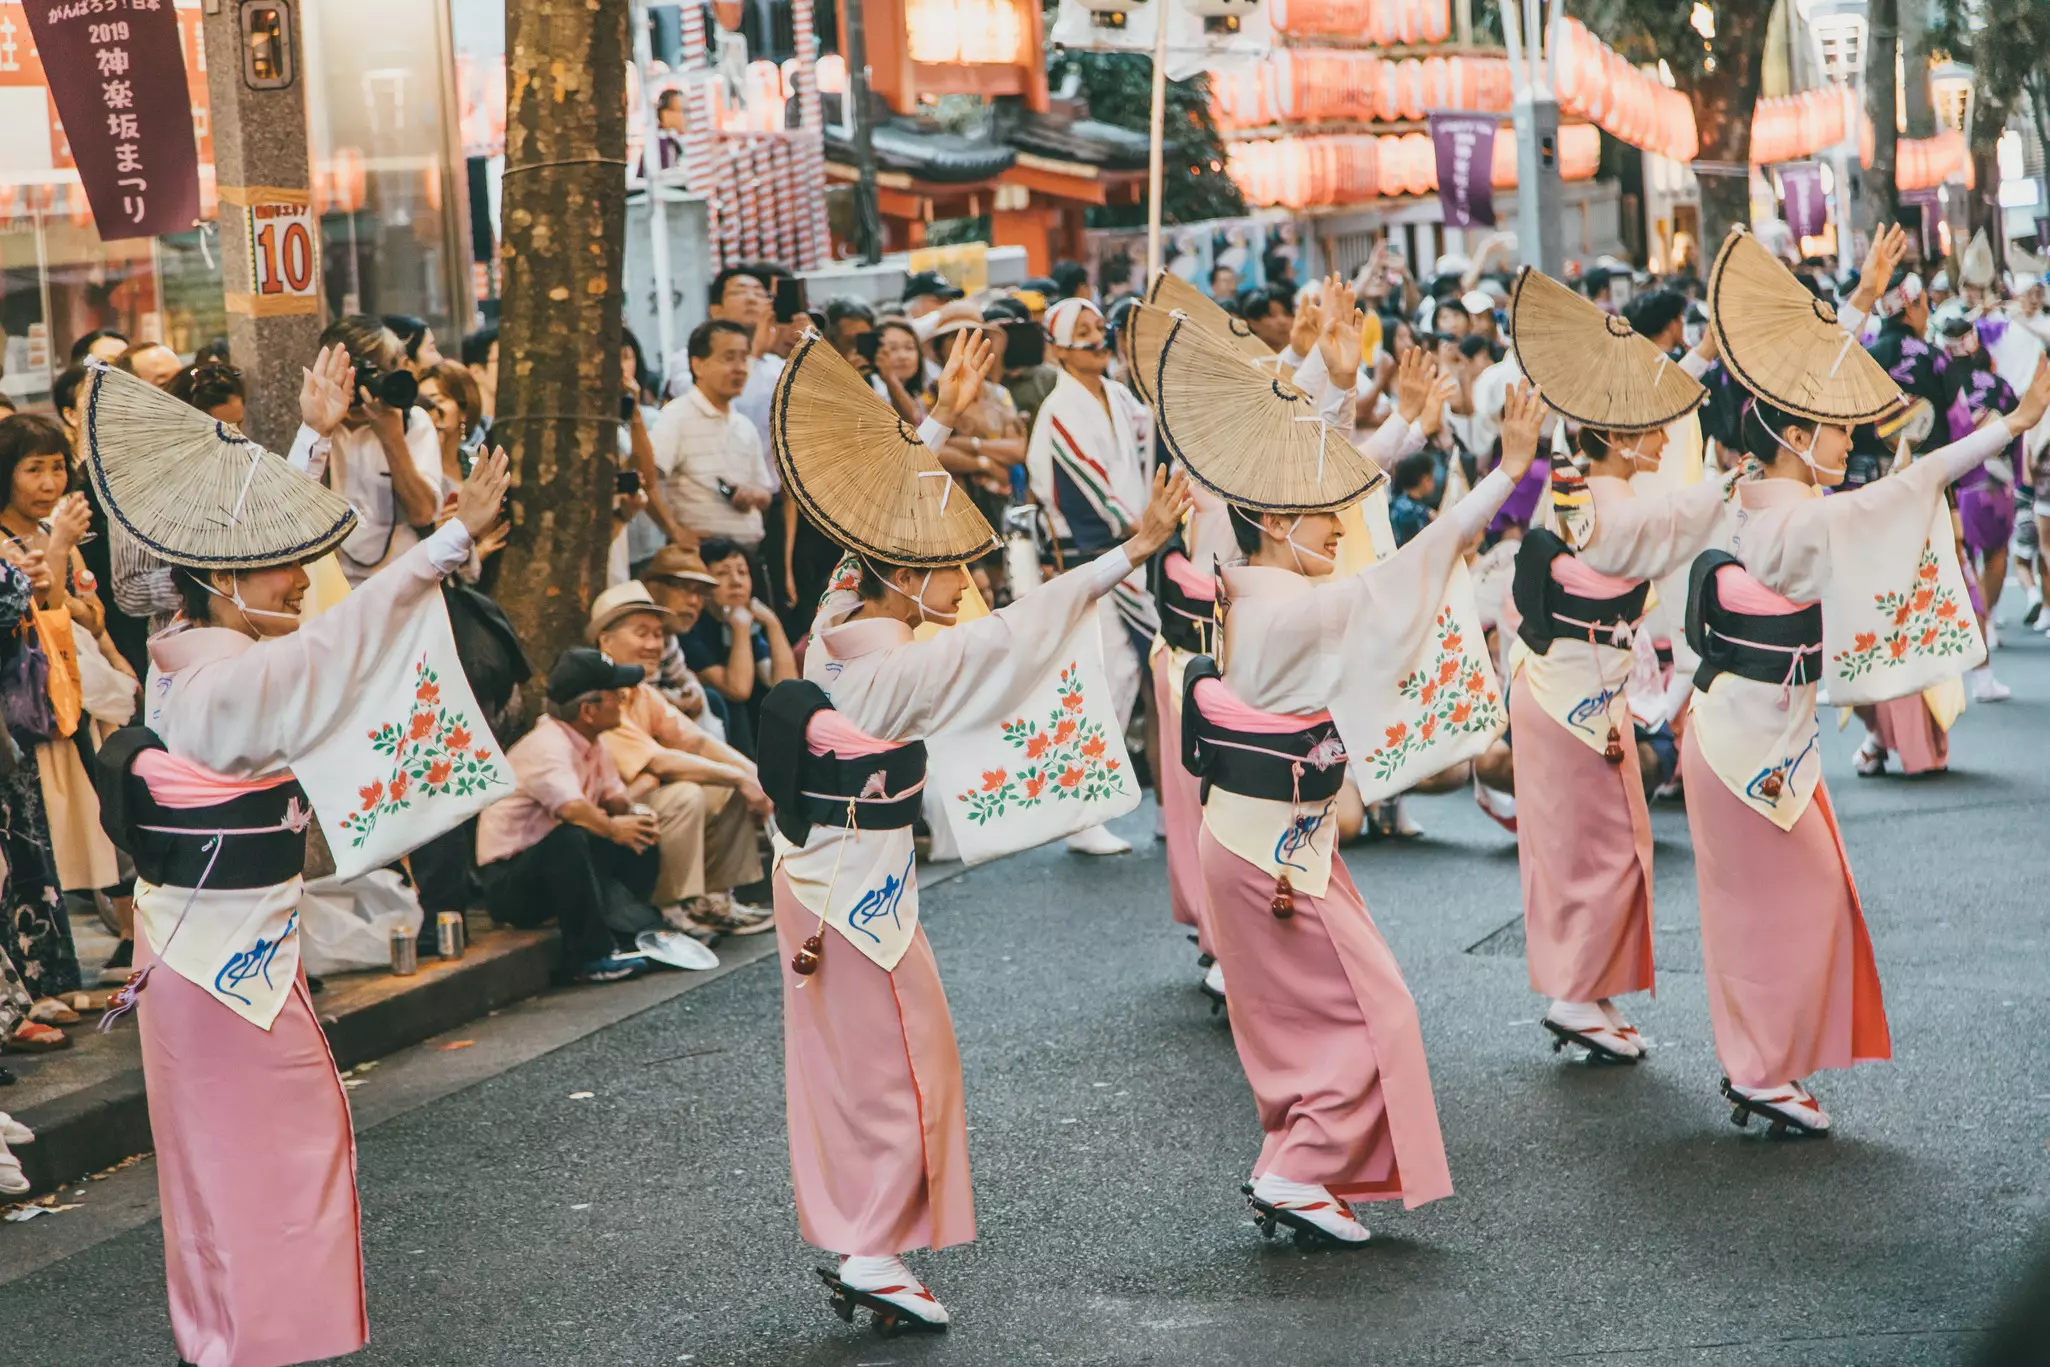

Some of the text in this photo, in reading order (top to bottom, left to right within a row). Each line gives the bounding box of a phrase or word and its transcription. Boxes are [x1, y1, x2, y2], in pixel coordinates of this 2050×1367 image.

[88, 21, 130, 43] 2019
[96, 47, 147, 224] 神楽坂まつり
[258, 222, 312, 294] 10
